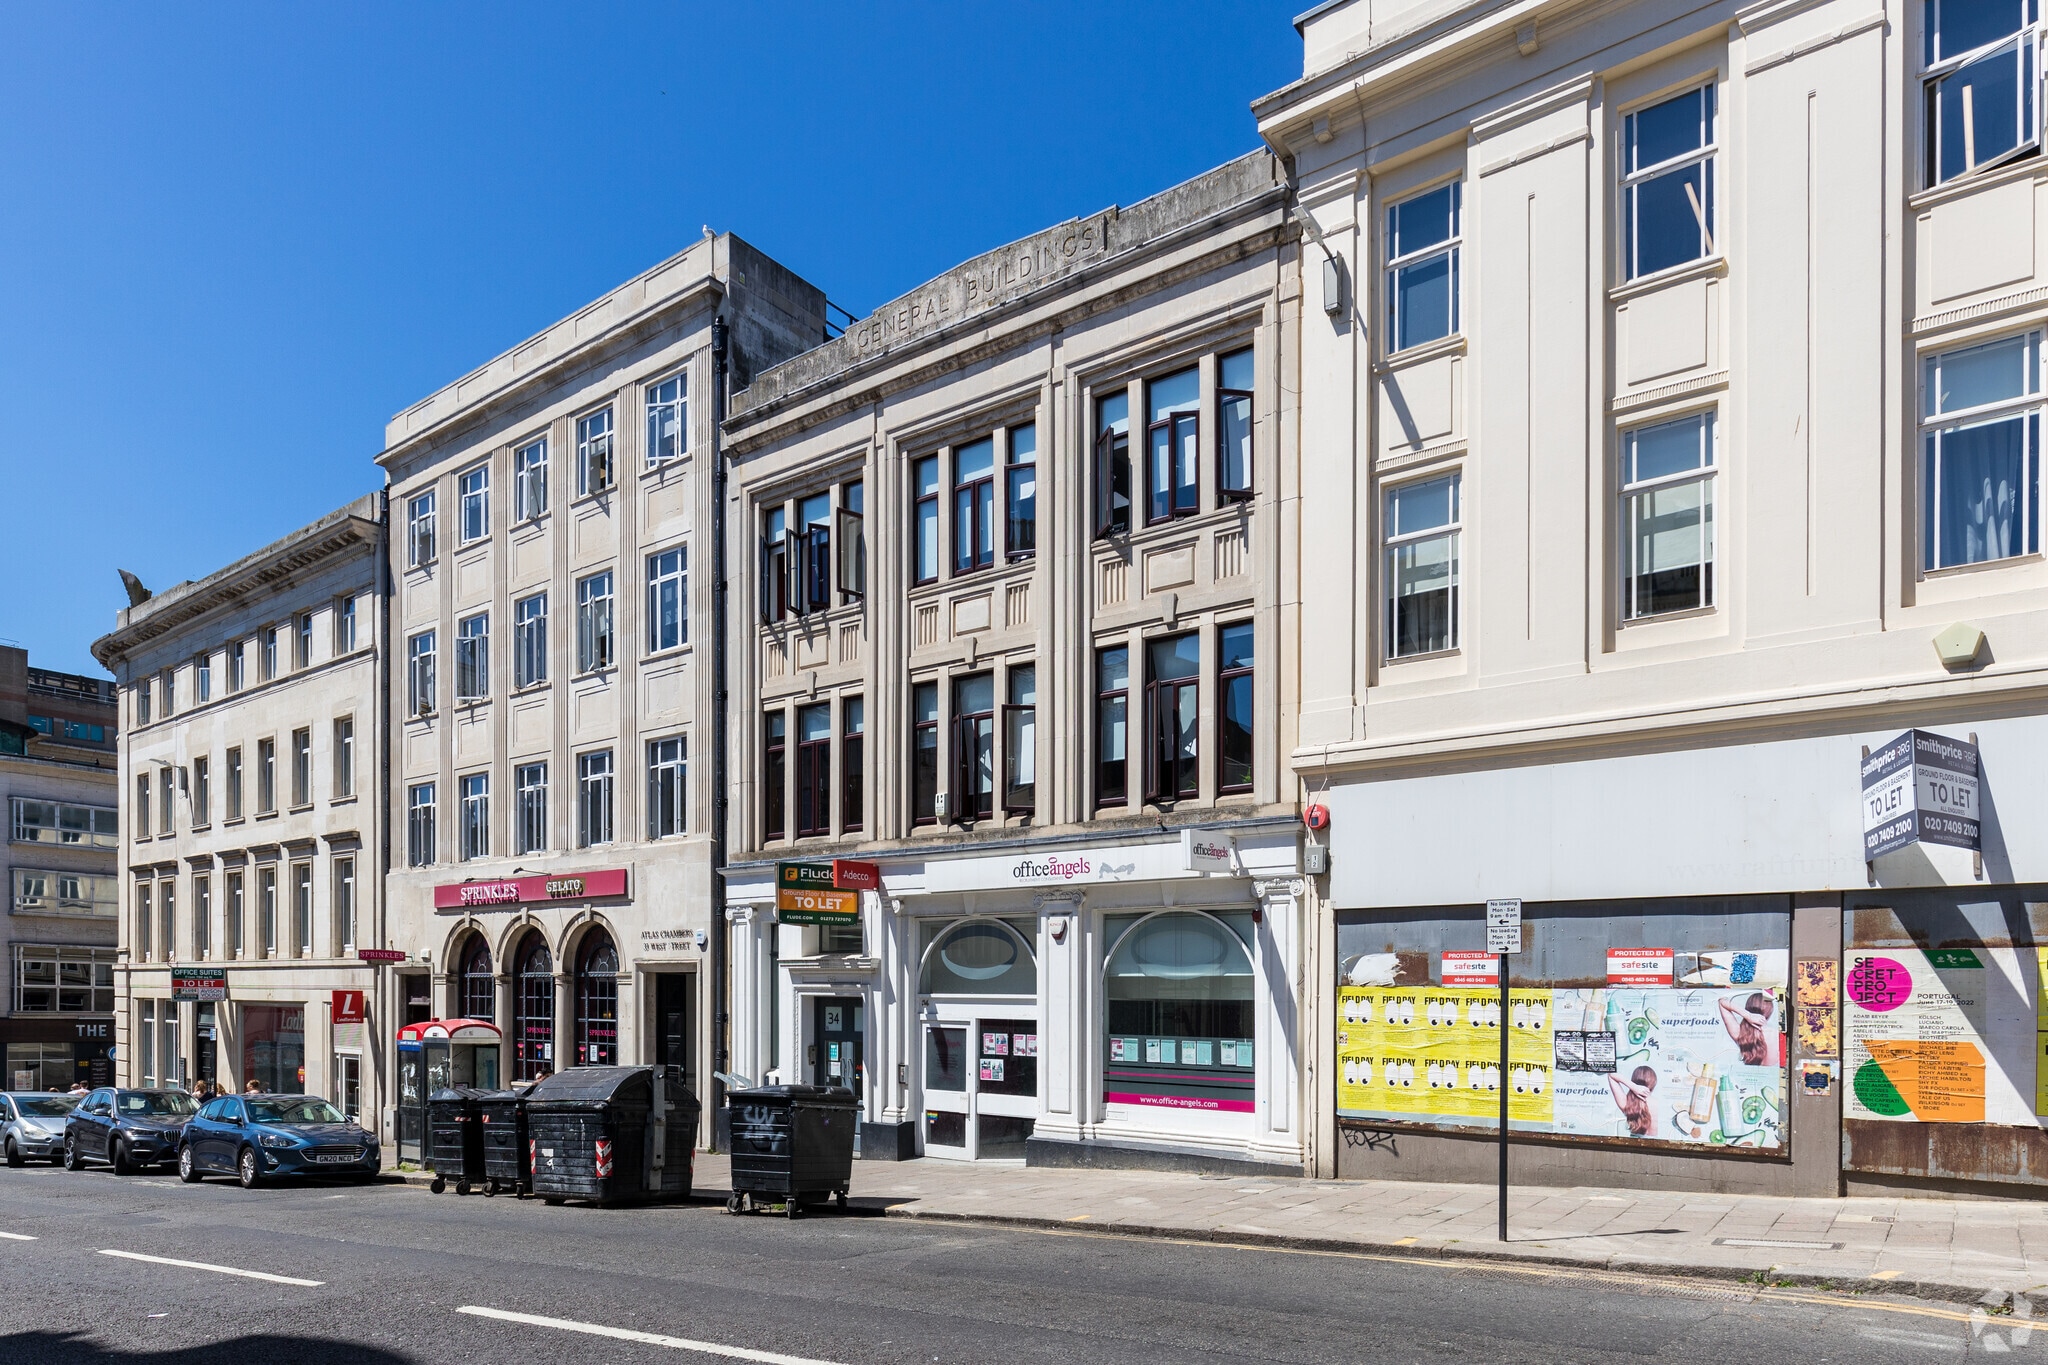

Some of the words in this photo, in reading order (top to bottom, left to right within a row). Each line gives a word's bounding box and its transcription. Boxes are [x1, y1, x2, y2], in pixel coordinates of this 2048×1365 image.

[857, 295, 950, 349] GENERAL
[968, 229, 1093, 301] BUILDINGS
[1916, 738, 1963, 760] smithprice
[1963, 750, 1976, 765] RRG
[1862, 750, 1896, 778] smithprice
[1875, 782, 1888, 795] FLOOR
[1891, 769, 1912, 787] BASEMENT
[1918, 768, 1939, 780] GROUND
[1939, 771, 1955, 783] FLOOR
[1958, 776, 1978, 788] BASEMENT
[1870, 797, 1883, 819] TO
[1885, 785, 1903, 812] LET
[1929, 782, 1948, 804] TO
[1951, 786, 1971, 809] LET
[1867, 834, 1879, 849] 020
[1879, 826, 1895, 845] 7409
[1895, 818, 1913, 836] 2100
[1924, 817, 1942, 831] 020
[1943, 818, 1963, 835] 7409
[1963, 823, 1978, 838] 2100
[1193, 842, 1228, 860] officeangels
[1013, 857, 1091, 879] officeangels
[843, 870, 869, 881] Adecco
[460, 883, 517, 901] SPRINKLES
[546, 879, 582, 893] GELATO
[795, 896, 814, 908] TO
[818, 898, 843, 910] LET
[641, 931, 660, 940] ATLAS
[650, 942, 667, 951] WEST
[360, 951, 404, 959] SPRINKLES
[1454, 962, 1486, 970] safesite
[1621, 961, 1659, 969] safesite
[1854, 957, 1875, 968] SE
[1854, 969, 1897, 980] CRET
[1854, 980, 1887, 992] PRO
[342, 993, 356, 1015] L
[1855, 992, 1897, 1004] JECT
[828, 1013, 840, 1025] 34
[1661, 1017, 1720, 1027] superfoods
[75, 1024, 108, 1037] THE
[1555, 1087, 1609, 1096] superfoods
[1140, 1096, 1219, 1109] www.office-angels.com
